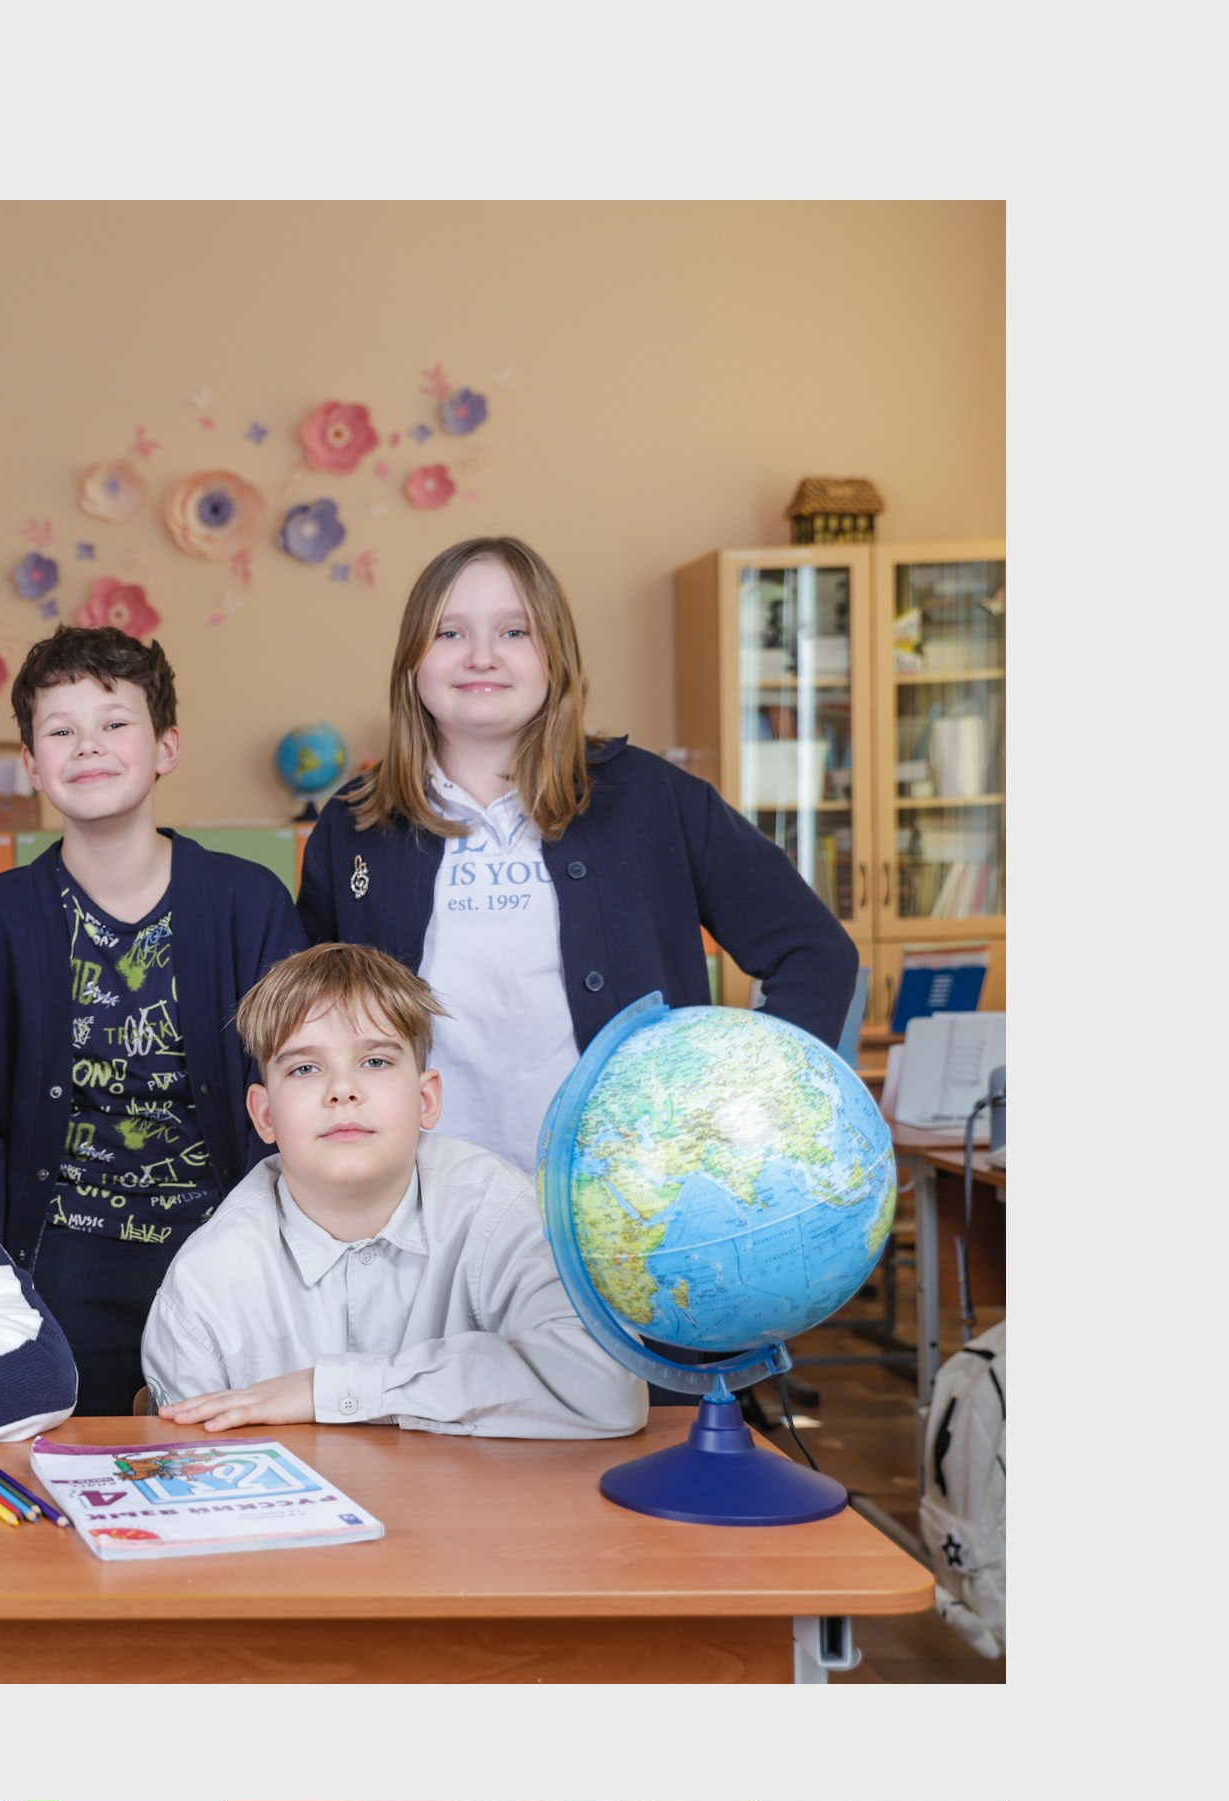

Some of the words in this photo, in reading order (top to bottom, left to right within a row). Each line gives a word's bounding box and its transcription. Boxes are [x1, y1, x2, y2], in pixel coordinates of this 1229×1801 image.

[448, 861, 476, 887] IS
[485, 861, 553, 886] YOU
[447, 896, 479, 911] est.
[487, 894, 531, 911] 1997
[77, 1489, 128, 1508] 4
[187, 1495, 338, 1516] РУССКИЙ
[85, 1508, 180, 1523] ЯЗЫК
